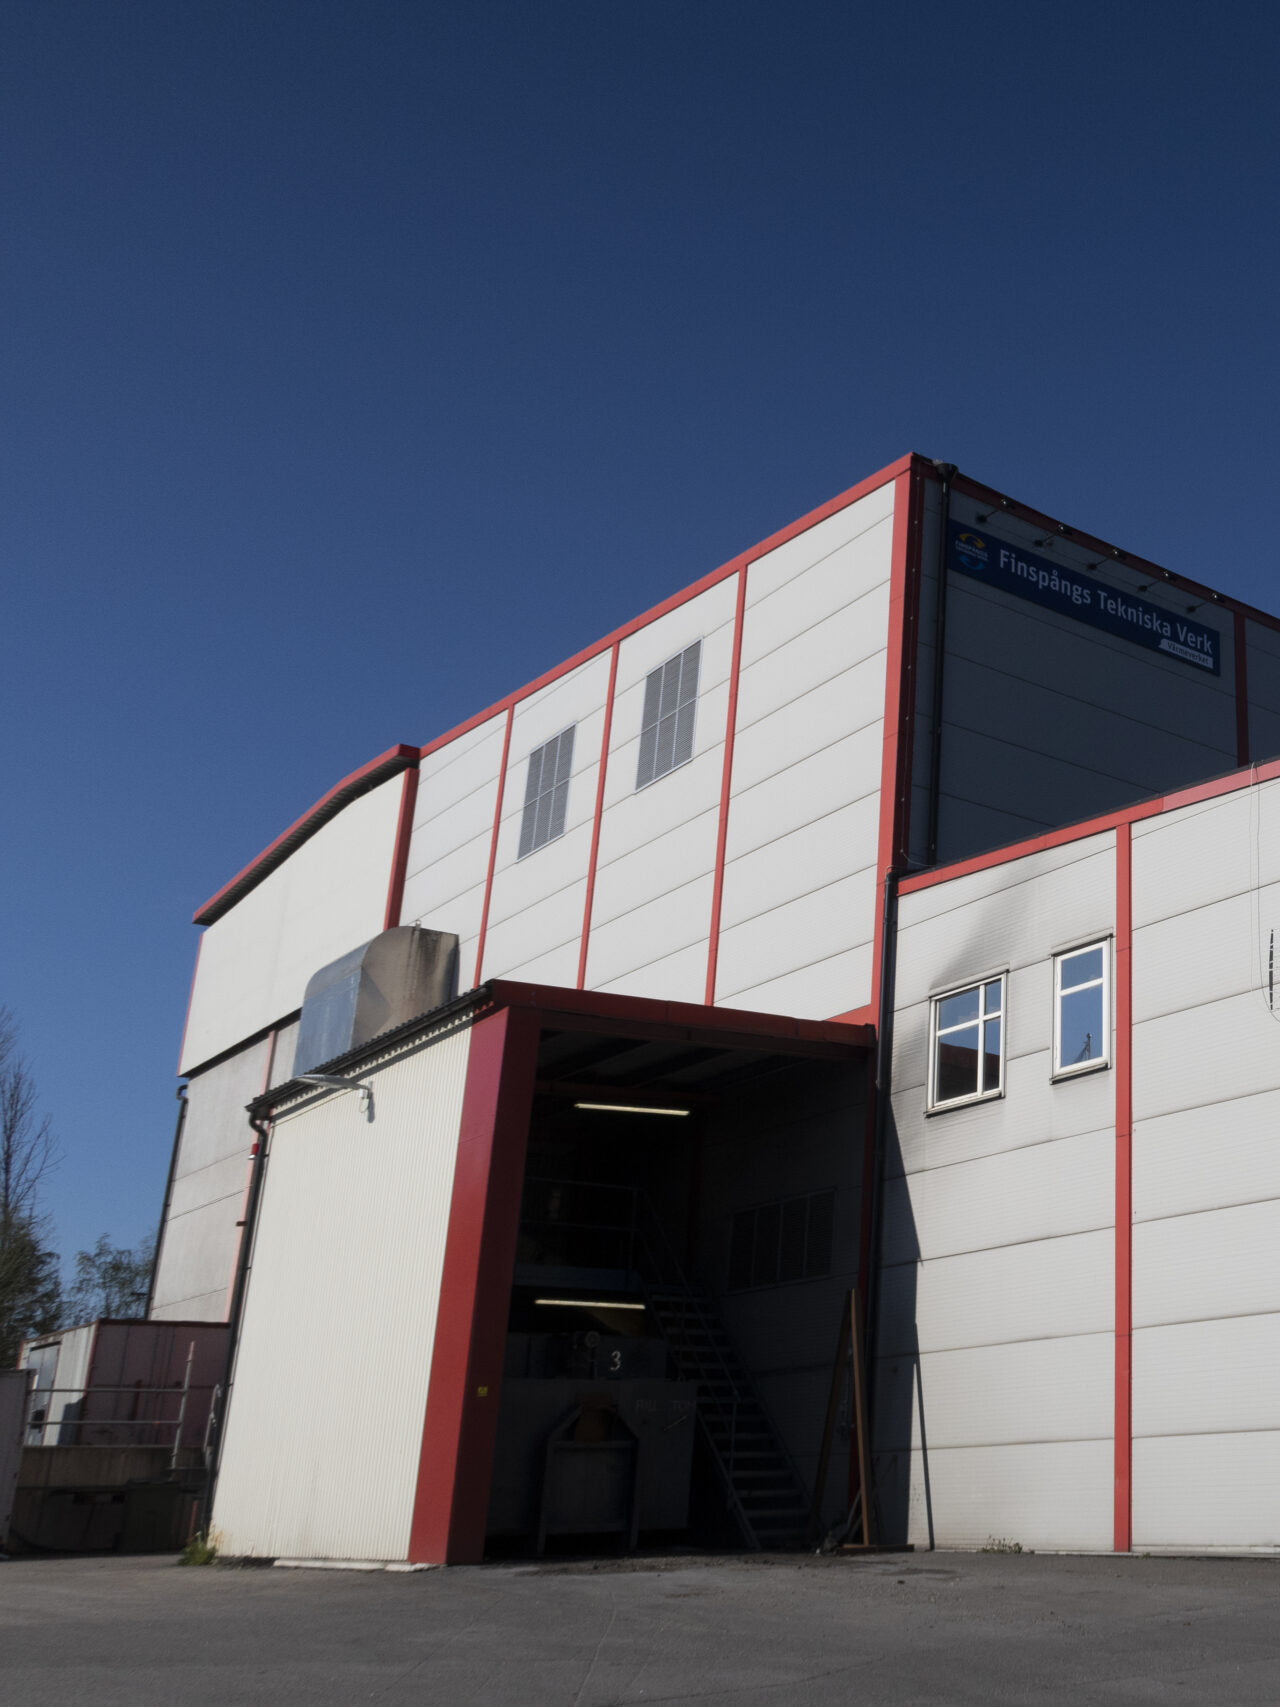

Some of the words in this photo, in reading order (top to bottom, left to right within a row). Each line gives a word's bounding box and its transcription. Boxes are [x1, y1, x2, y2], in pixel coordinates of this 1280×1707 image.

[1000, 549, 1091, 604] Finspångs
[1097, 590, 1171, 637] Tekniska
[1176, 623, 1213, 655] Verk
[609, 1350, 622, 1371] 3
